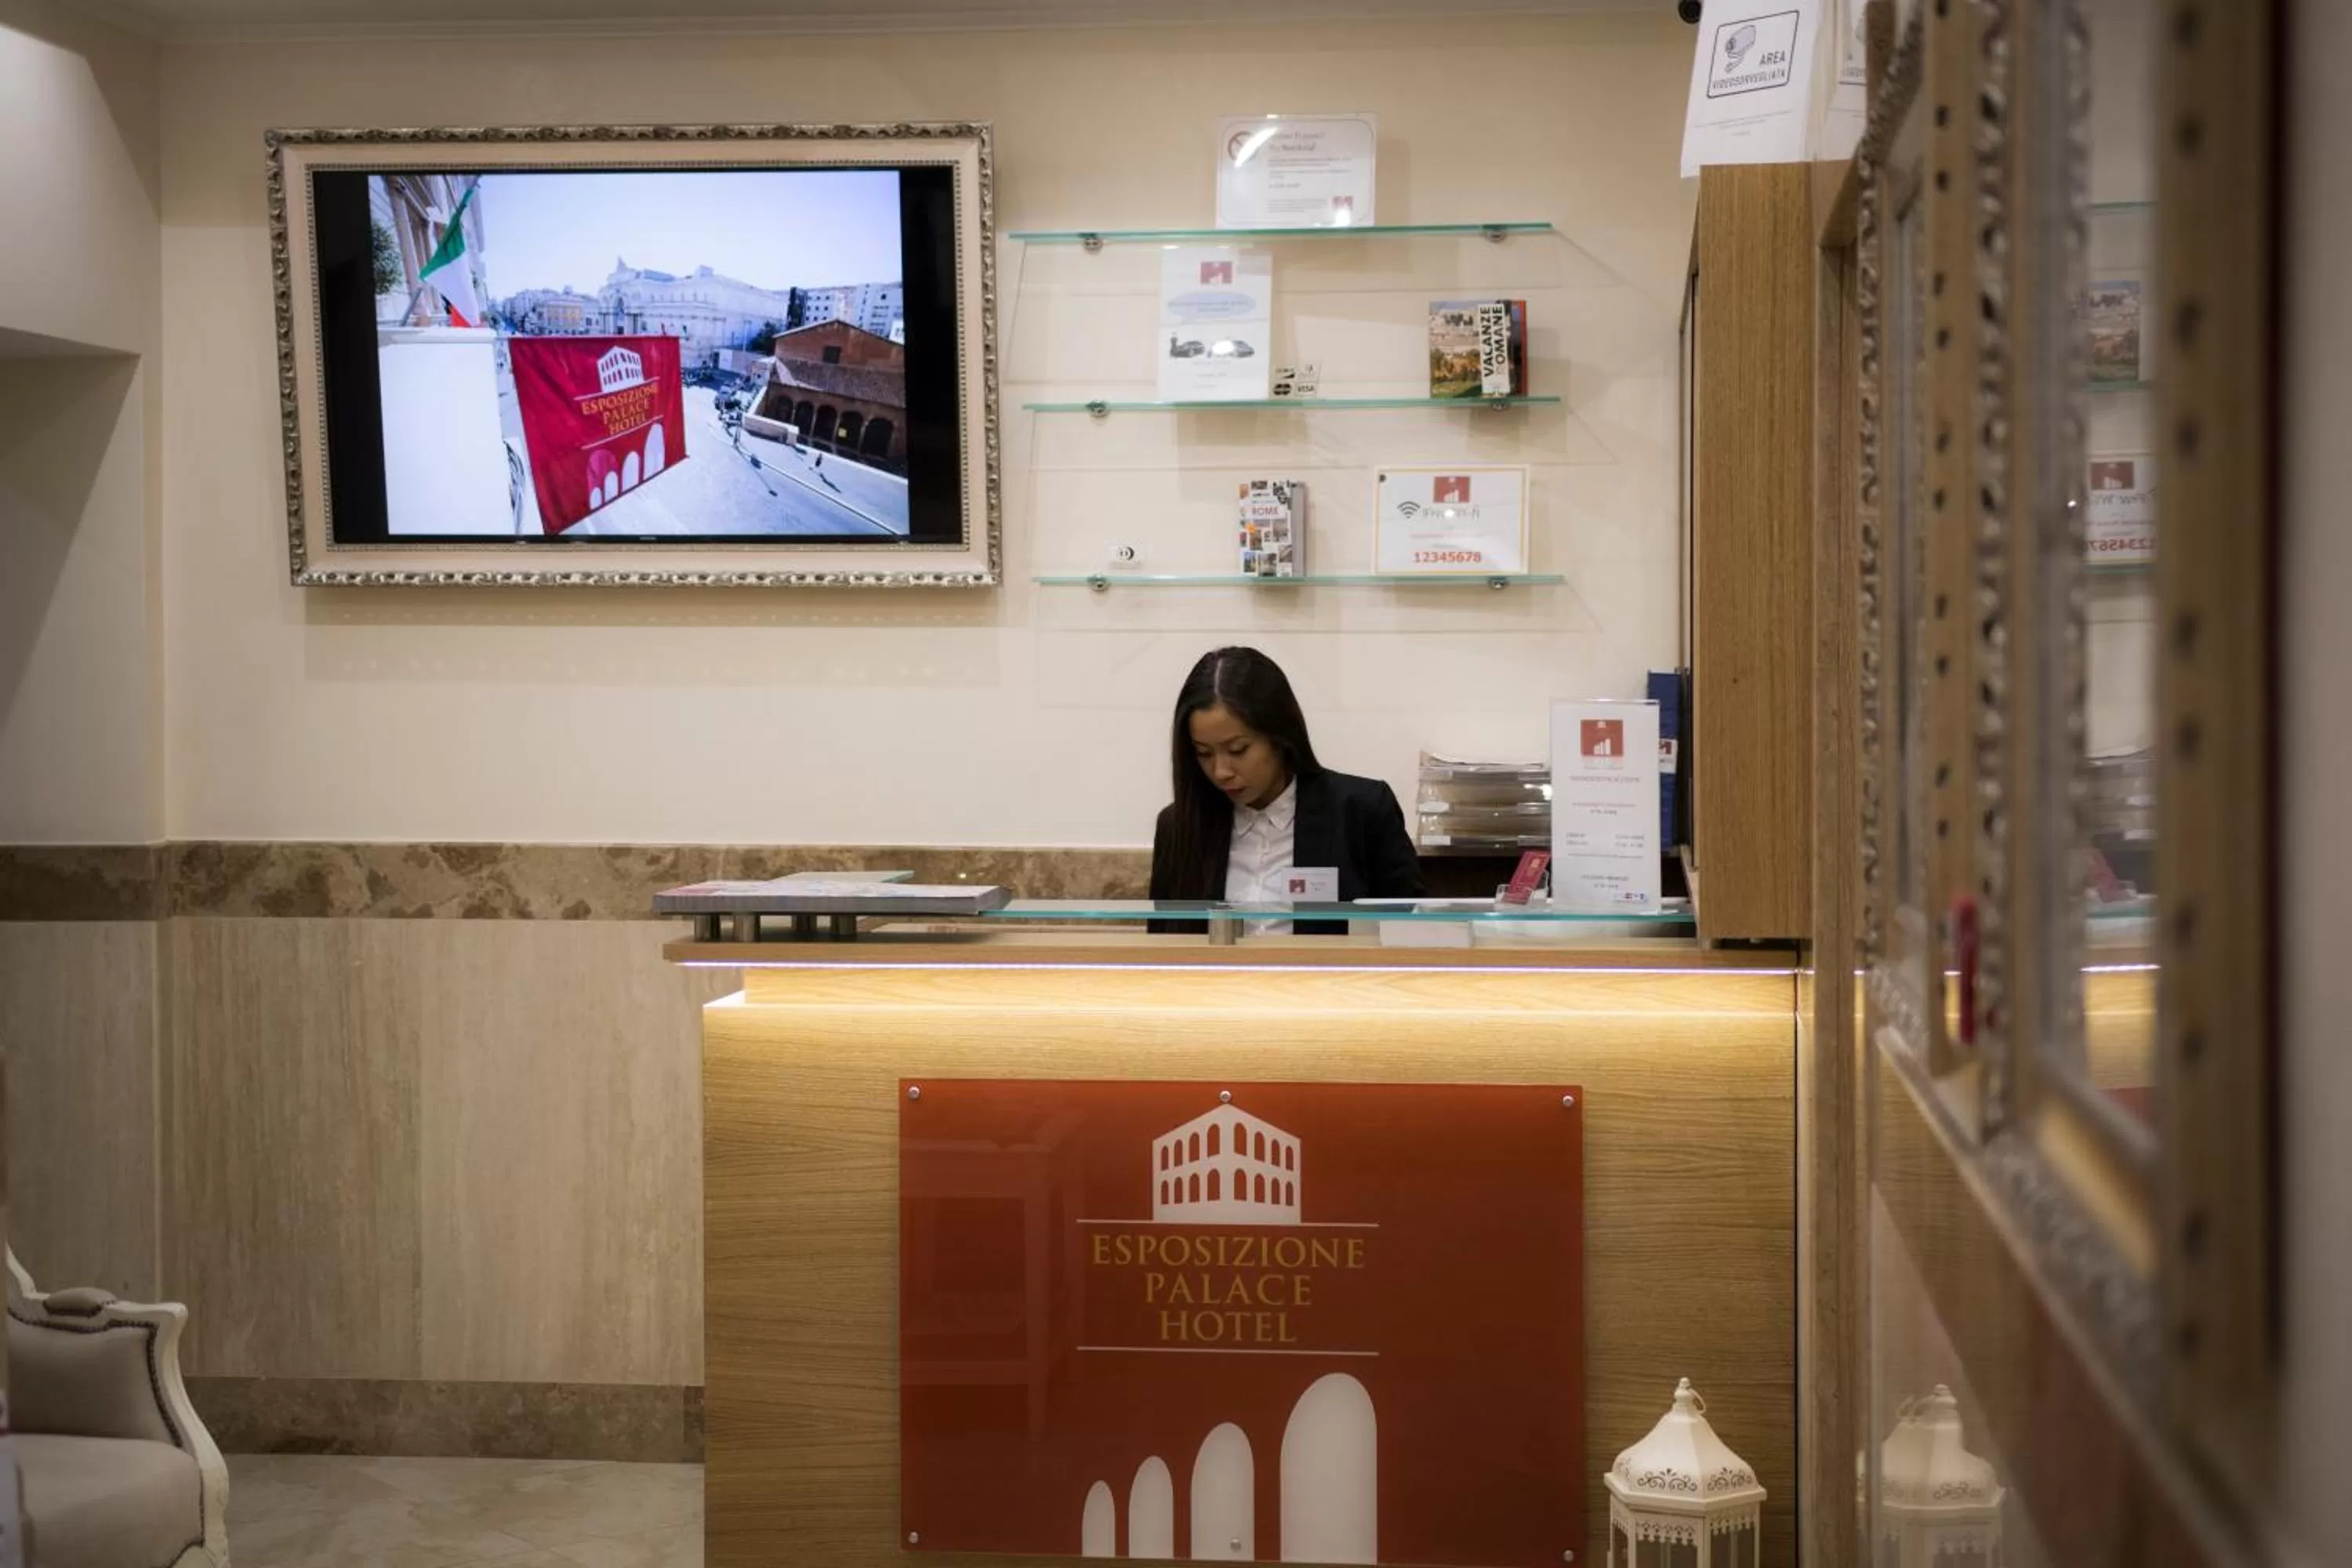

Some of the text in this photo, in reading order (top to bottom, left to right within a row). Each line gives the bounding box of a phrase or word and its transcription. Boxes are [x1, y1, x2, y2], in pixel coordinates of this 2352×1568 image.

[1759, 50, 1785, 66] AREA
[1479, 307, 1494, 377] VACANZE
[603, 397, 650, 425] PALACE
[608, 413, 646, 435] HOTEL
[1414, 551, 1481, 563] 12345678
[1091, 1234, 1366, 1269] ESPOSIZIONE
[1145, 1272, 1312, 1306] PALACE
[1160, 1309, 1298, 1343] HOTEL
